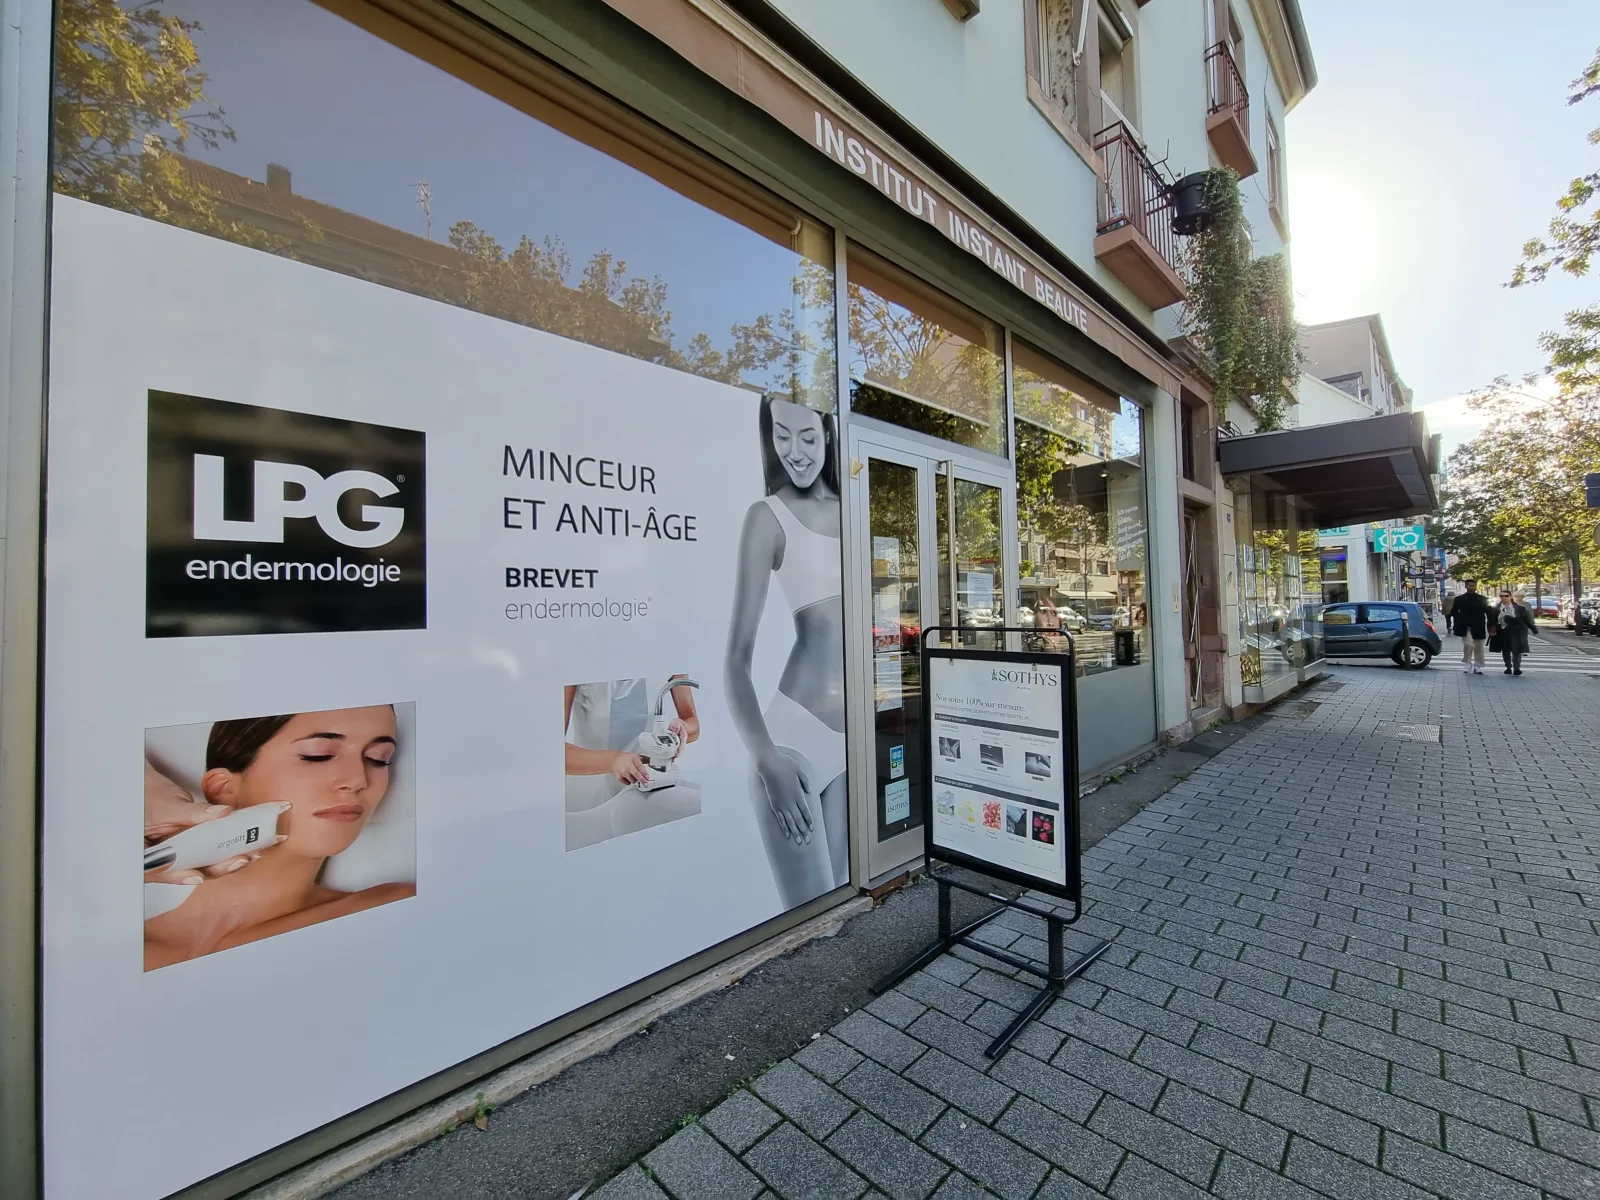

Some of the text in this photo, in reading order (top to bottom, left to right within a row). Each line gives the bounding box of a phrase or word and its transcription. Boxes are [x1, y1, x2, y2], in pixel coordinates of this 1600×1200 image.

[814, 110, 1088, 333] INSTITUT INSTANT BEAUTE
[503, 444, 657, 495] MINCEUR
[503, 497, 698, 542] ET ANTI-ÂGE
[185, 553, 402, 588] endermologie
[505, 567, 599, 588] BREVET
[998, 669, 1058, 687] SOTHYS
[935, 693, 947, 702] Nos
[948, 695, 963, 704] soins
[966, 696, 983, 706] 100%
[217, 834, 246, 849] ergolift
